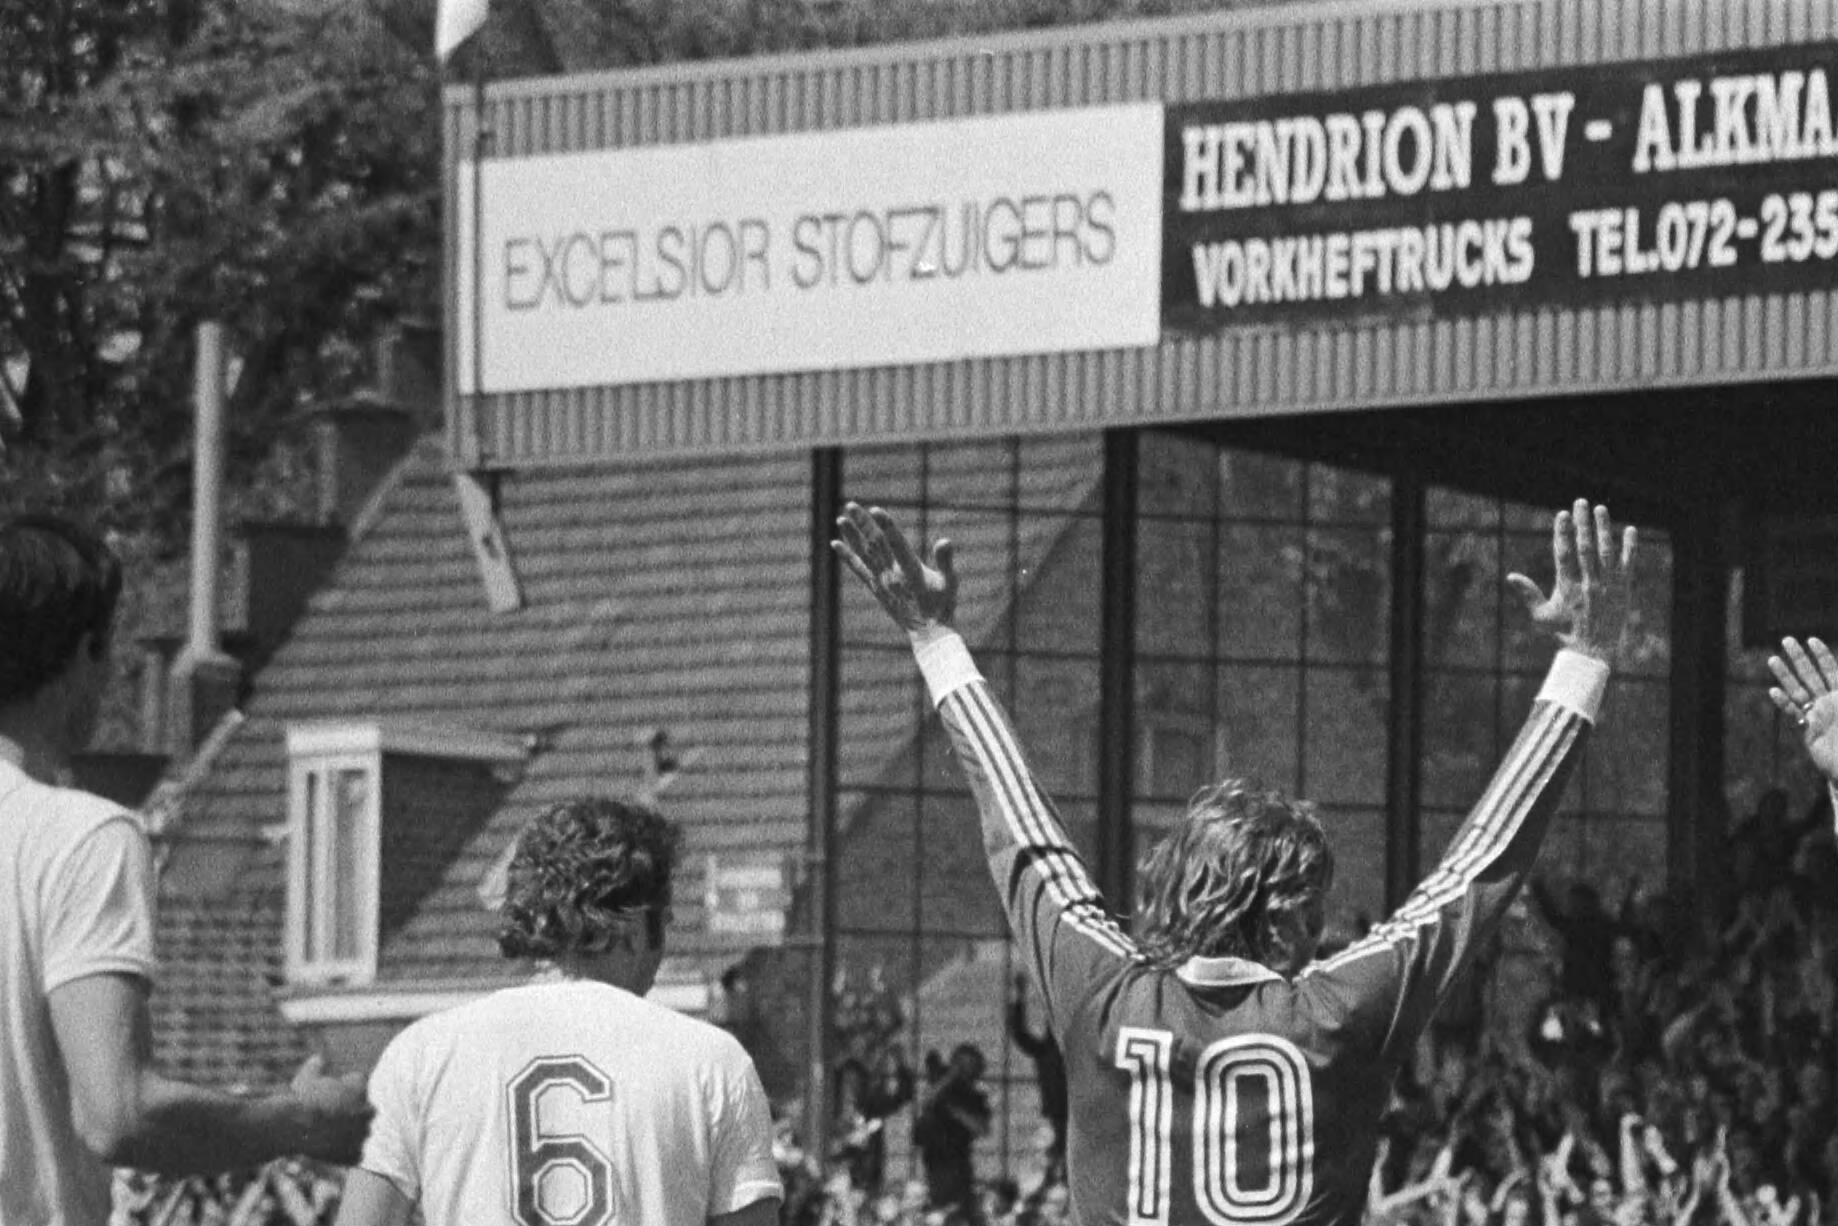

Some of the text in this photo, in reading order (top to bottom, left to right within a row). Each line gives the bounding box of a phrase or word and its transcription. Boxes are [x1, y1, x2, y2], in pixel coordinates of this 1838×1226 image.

[1179, 101, 1476, 211] HENDRION
[504, 190, 1117, 311] EXCELSIOR STOFZUIGERS
[1192, 215, 1534, 308] VORKHEFTRUCKS
